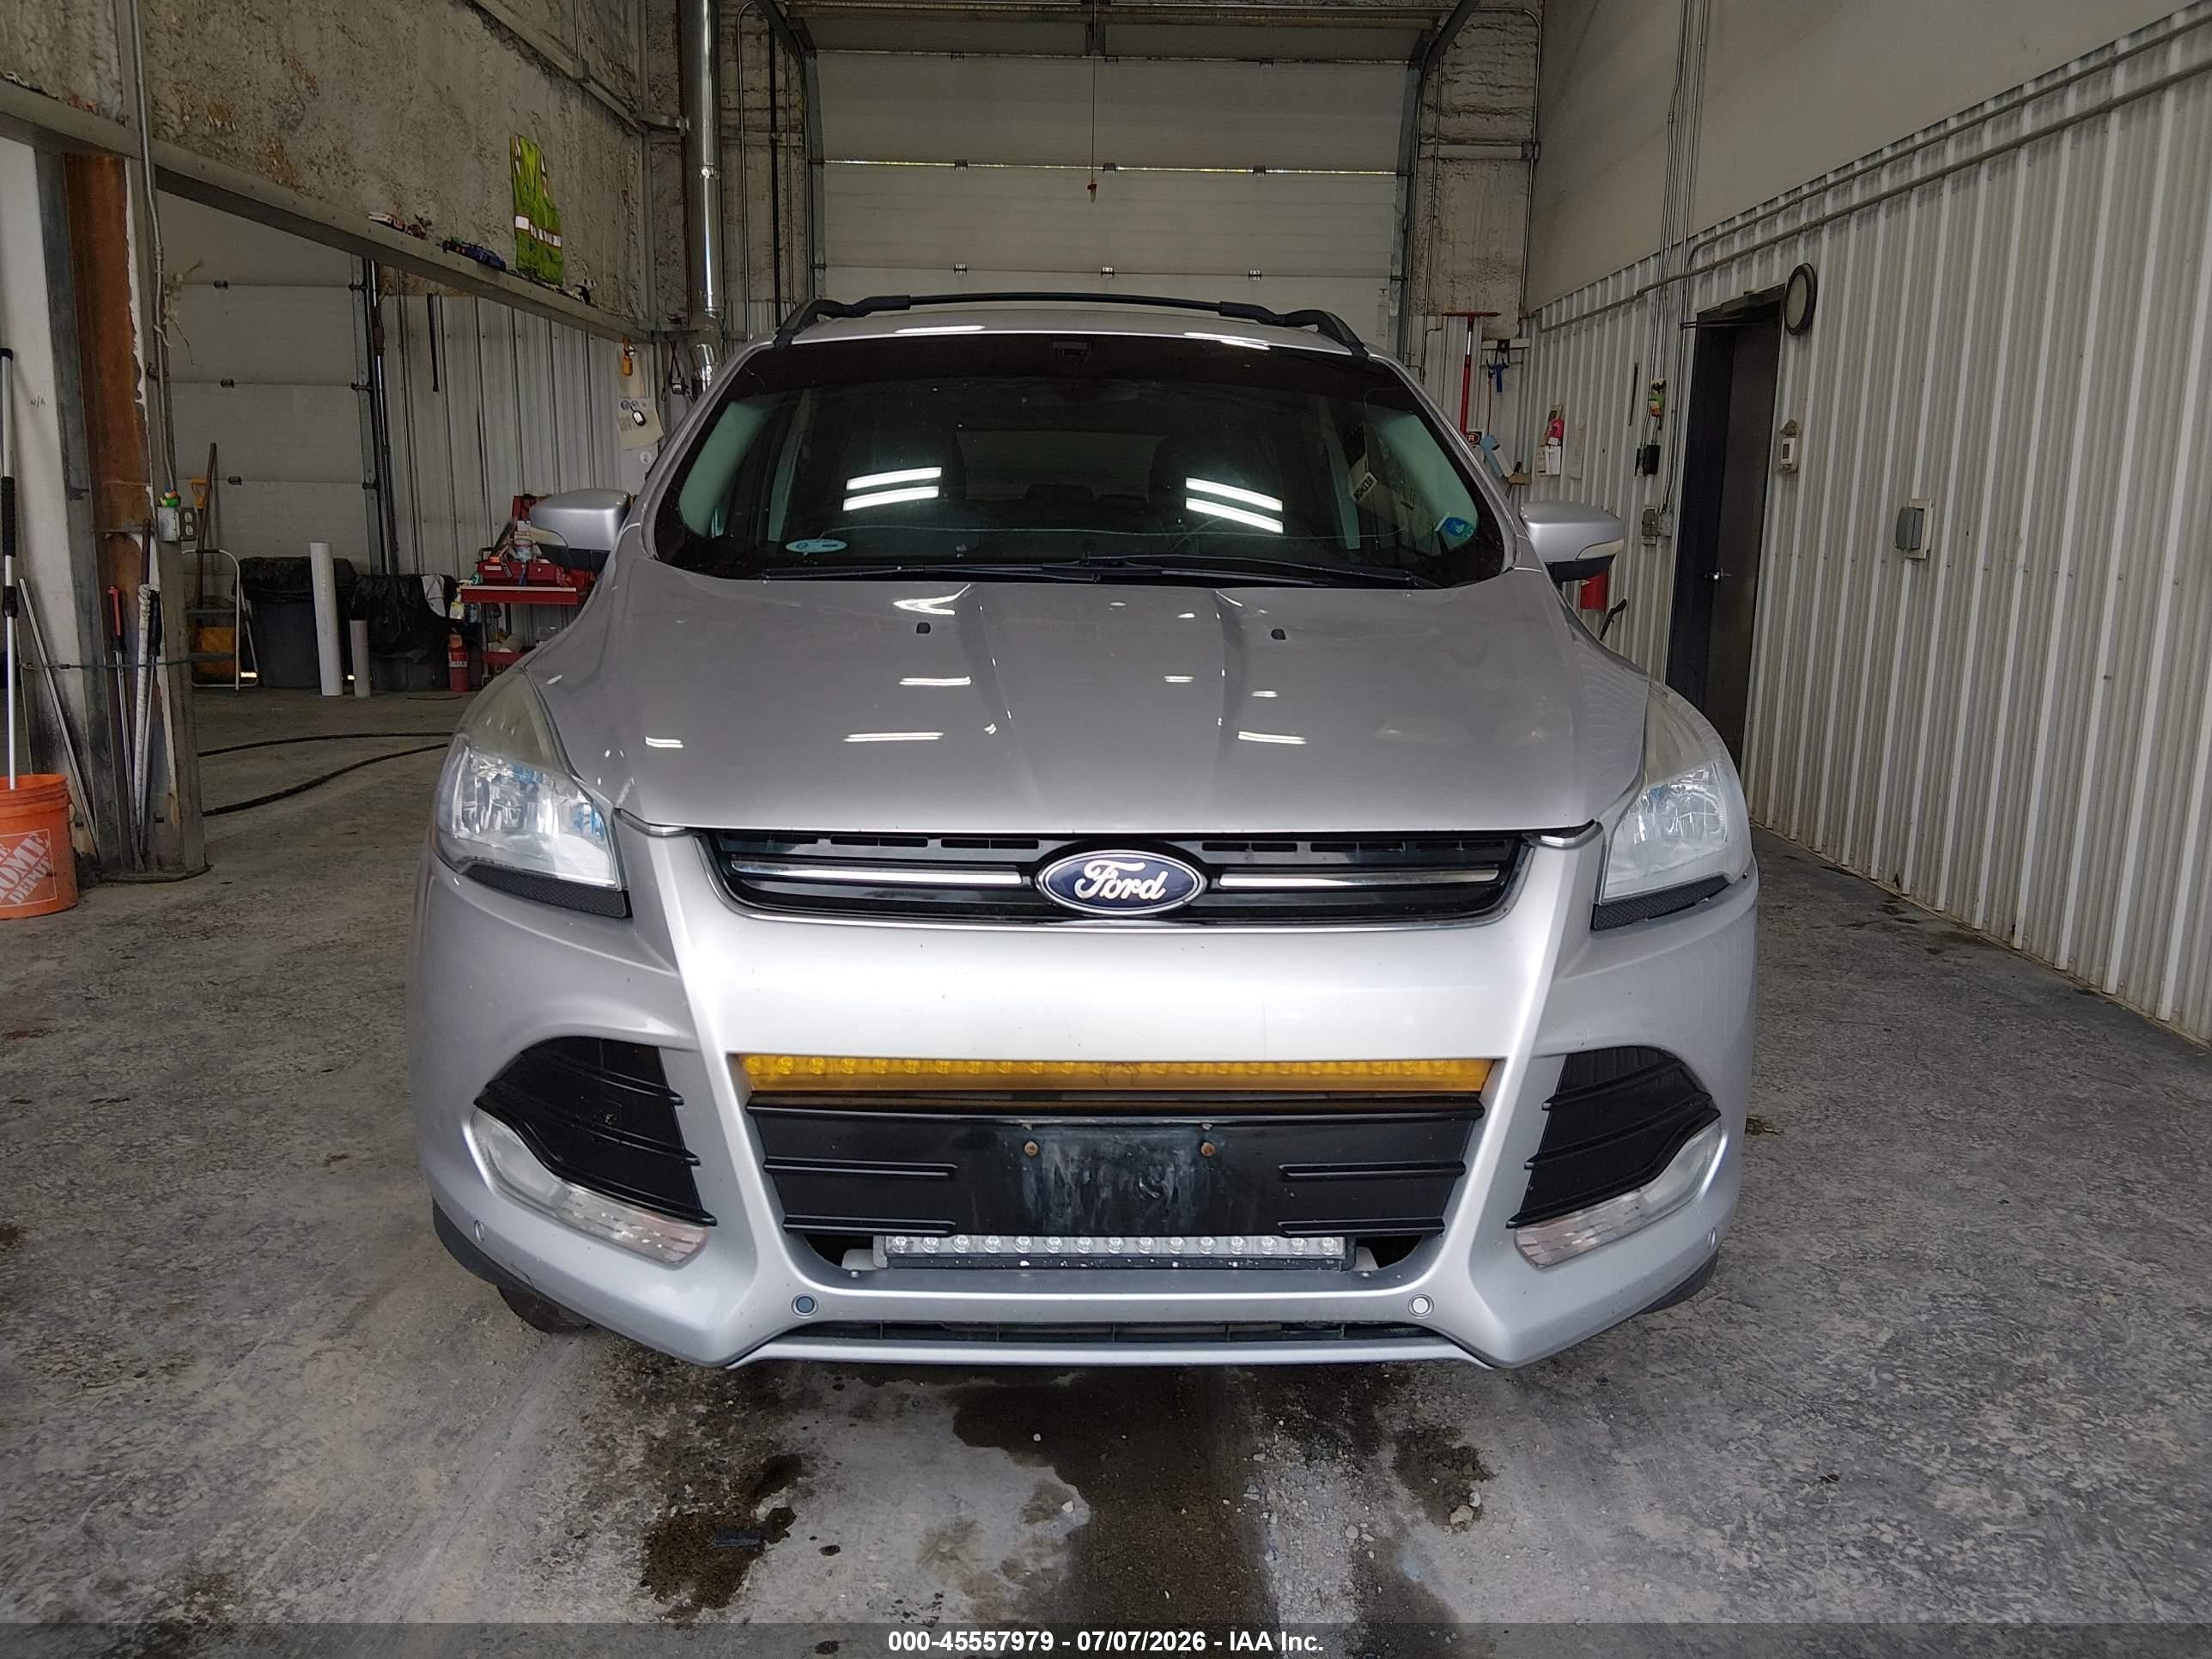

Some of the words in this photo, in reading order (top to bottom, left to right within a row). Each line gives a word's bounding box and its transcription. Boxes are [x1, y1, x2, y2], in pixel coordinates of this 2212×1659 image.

[0, 831, 50, 900] OME
[8, 855, 52, 904] DEPOT
[1074, 860, 1169, 900] Ford
